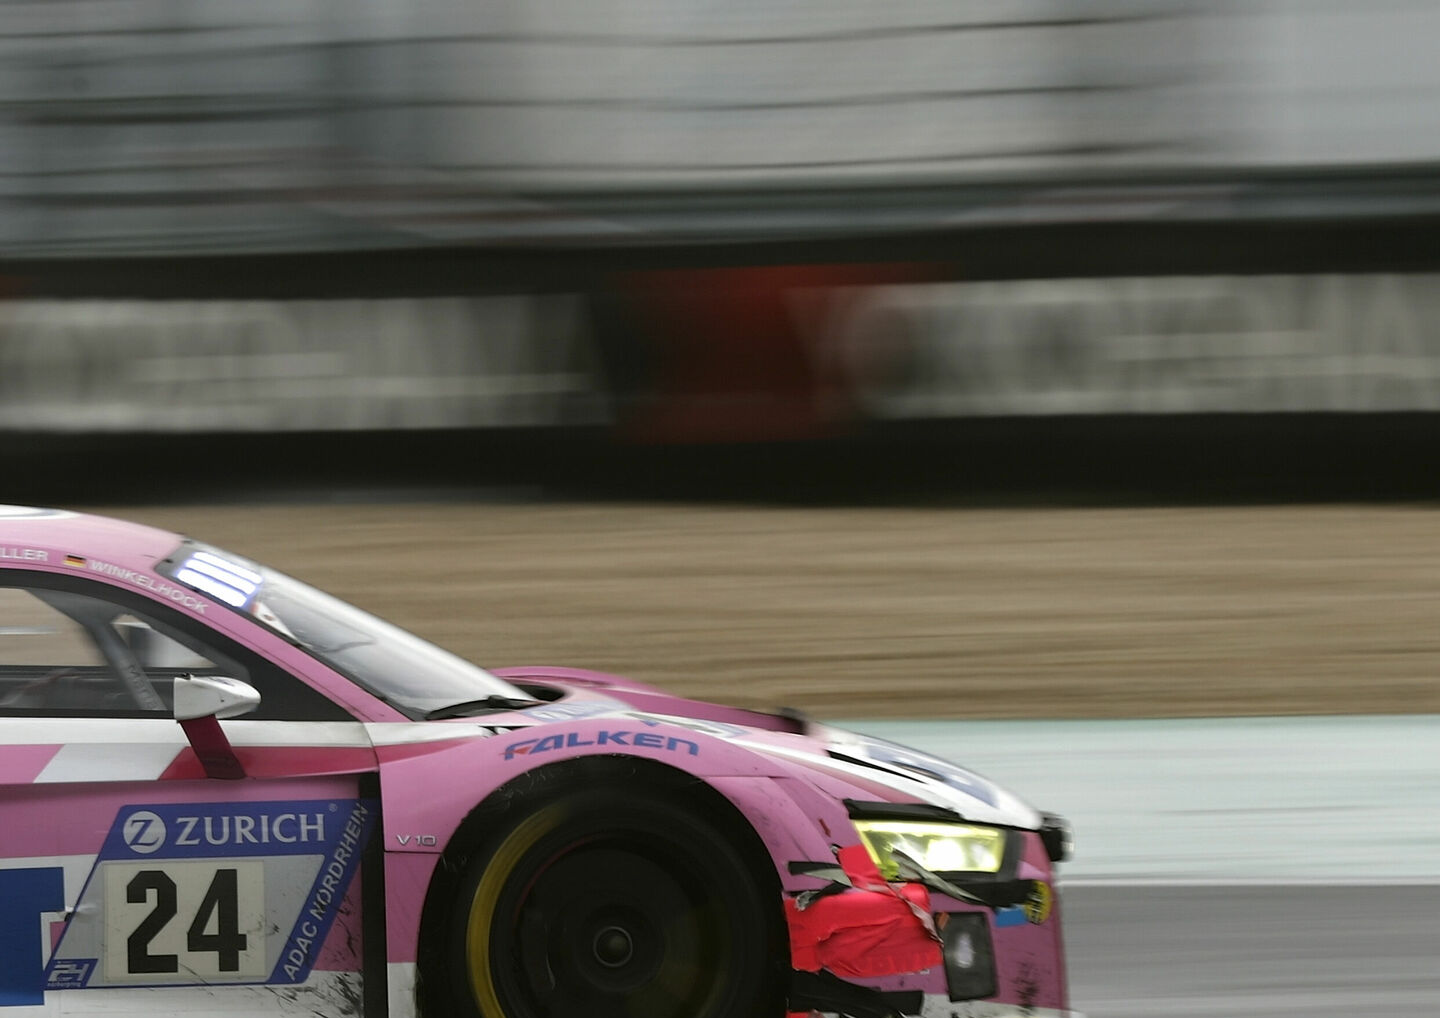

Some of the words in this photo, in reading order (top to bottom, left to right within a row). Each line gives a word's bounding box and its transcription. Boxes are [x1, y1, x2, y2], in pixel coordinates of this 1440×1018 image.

[89, 560, 208, 615] WINKELHOCK
[501, 731, 700, 761] FALKEN
[174, 812, 326, 846] ZURICH
[283, 921, 318, 981] ADAC
[310, 803, 369, 921] NORDRHEIN
[126, 868, 248, 975] 24
